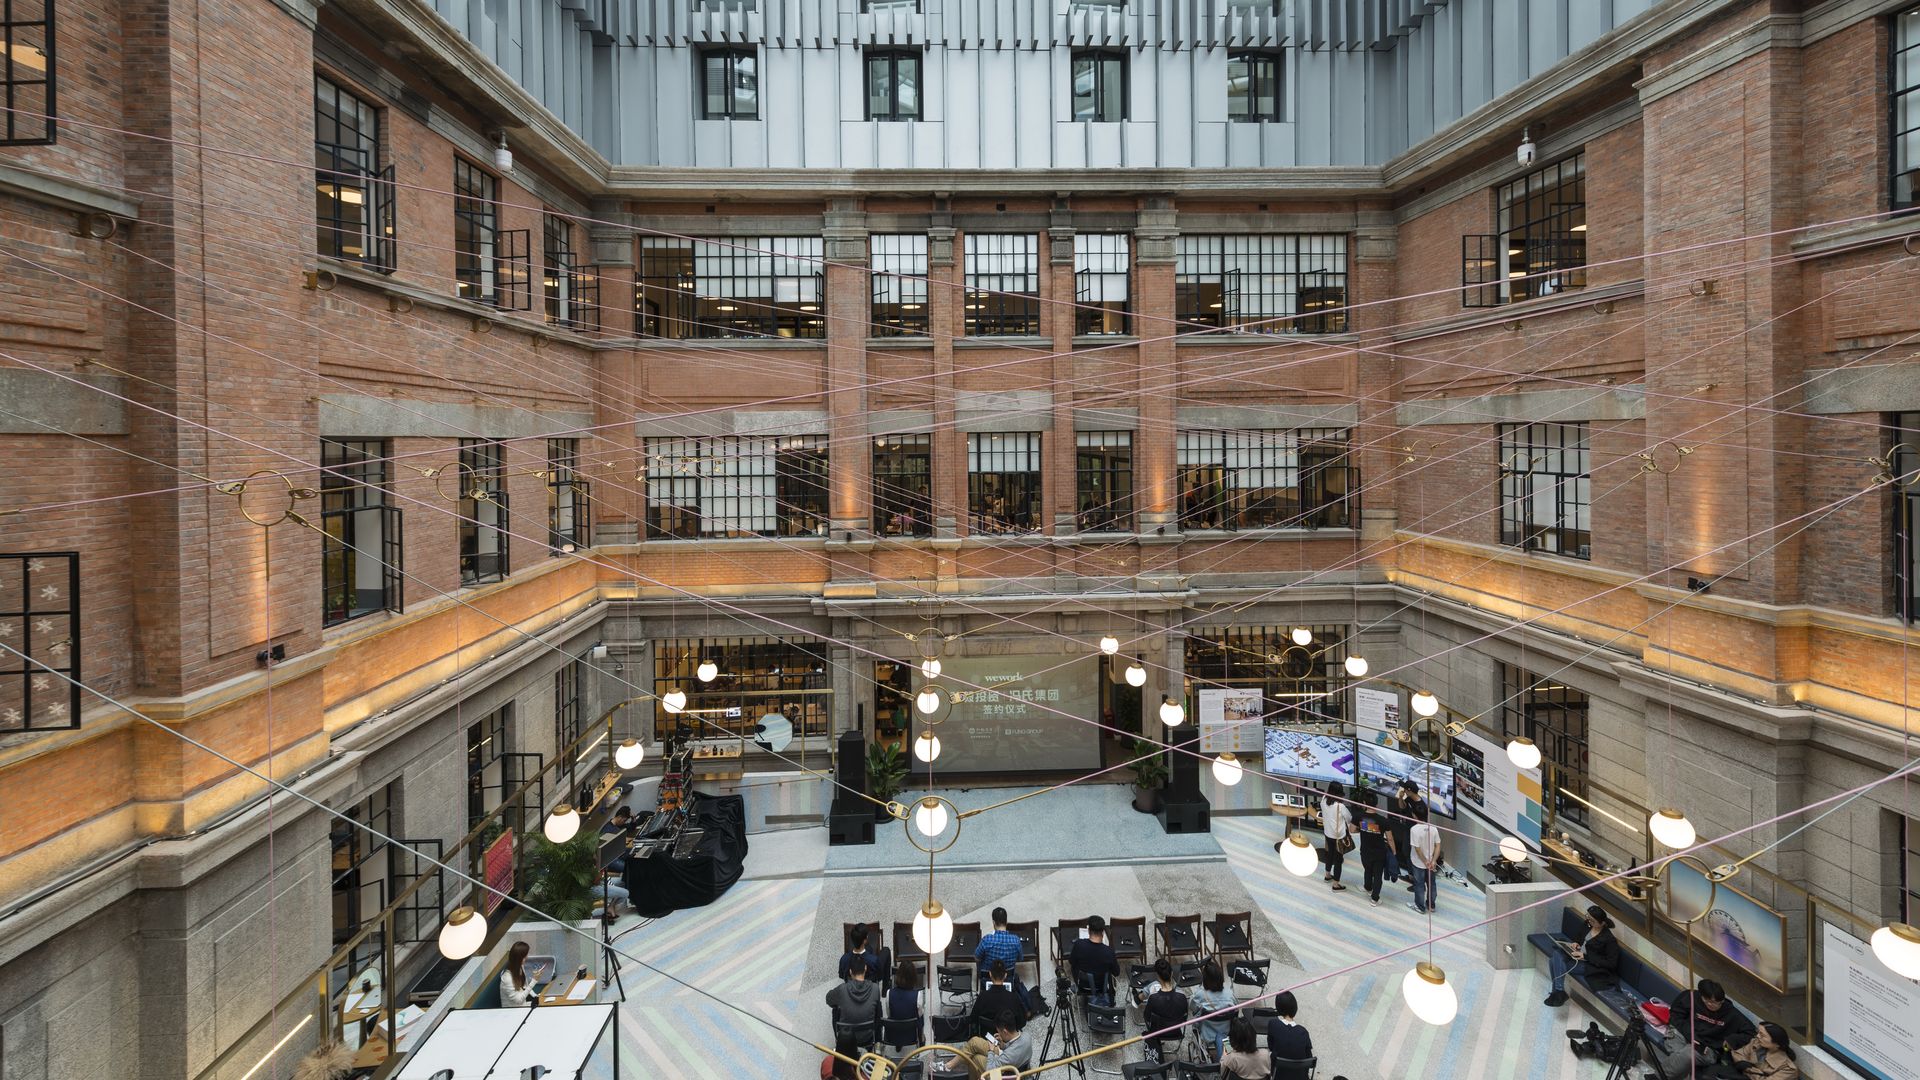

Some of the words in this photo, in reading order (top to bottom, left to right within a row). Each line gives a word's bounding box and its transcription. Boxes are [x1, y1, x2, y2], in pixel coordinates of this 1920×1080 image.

[984, 672, 1024, 682] wework
[983, 704, 1026, 714] 签约仪式
